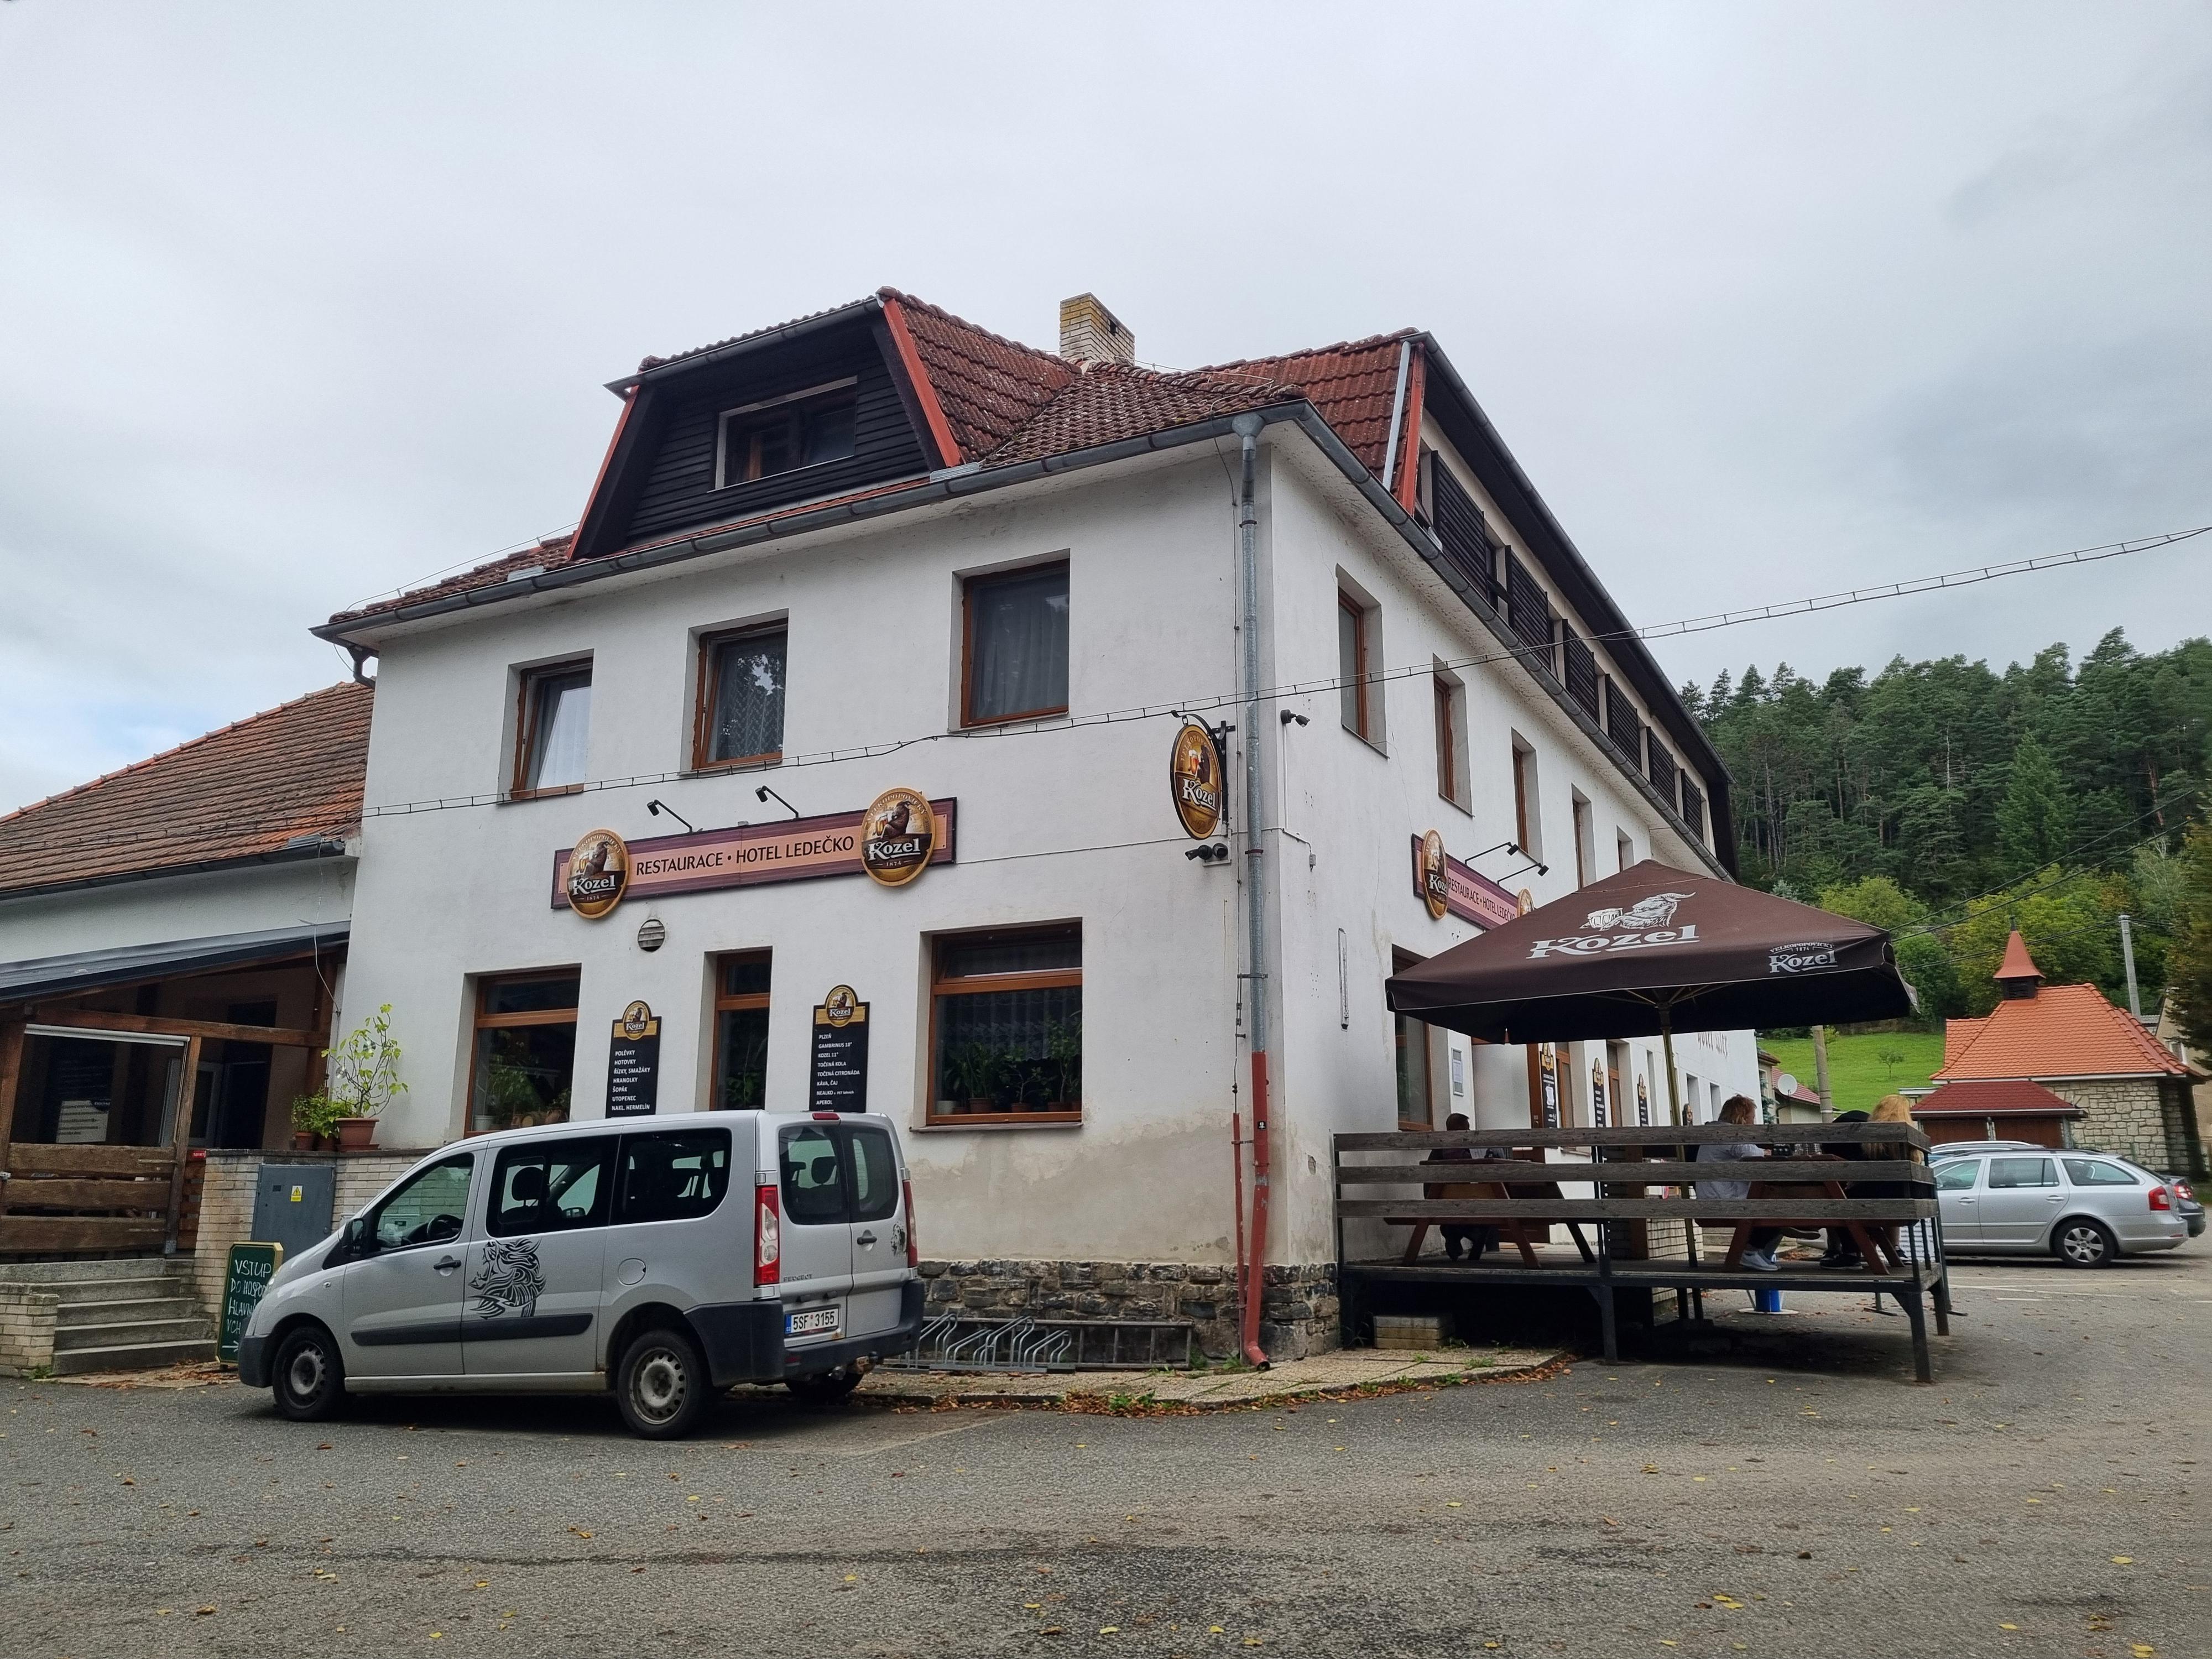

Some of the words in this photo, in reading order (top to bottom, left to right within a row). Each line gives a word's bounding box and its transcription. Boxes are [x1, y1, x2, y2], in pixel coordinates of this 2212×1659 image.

[1182, 778, 1216, 811] Kozel
[635, 852, 723, 875] RESTAURACE
[736, 841, 782, 865] HOTEL
[786, 834, 855, 859] LEDEČKO
[868, 838, 921, 861] Kozel
[572, 875, 617, 896] Kozel
[1449, 877, 1480, 905] RESTAURACE
[1483, 896, 1498, 915] HOTEL
[1525, 924, 1700, 960] Kozel
[1768, 950, 1839, 973] Kozel
[829, 1008, 851, 1017] Kozel
[626, 1022, 645, 1030] Kozel
[235, 1259, 272, 1277] VSTUP
[231, 1278, 242, 1293] DO
[793, 1314, 809, 1330] 5SF
[815, 1311, 835, 1327] 3155
